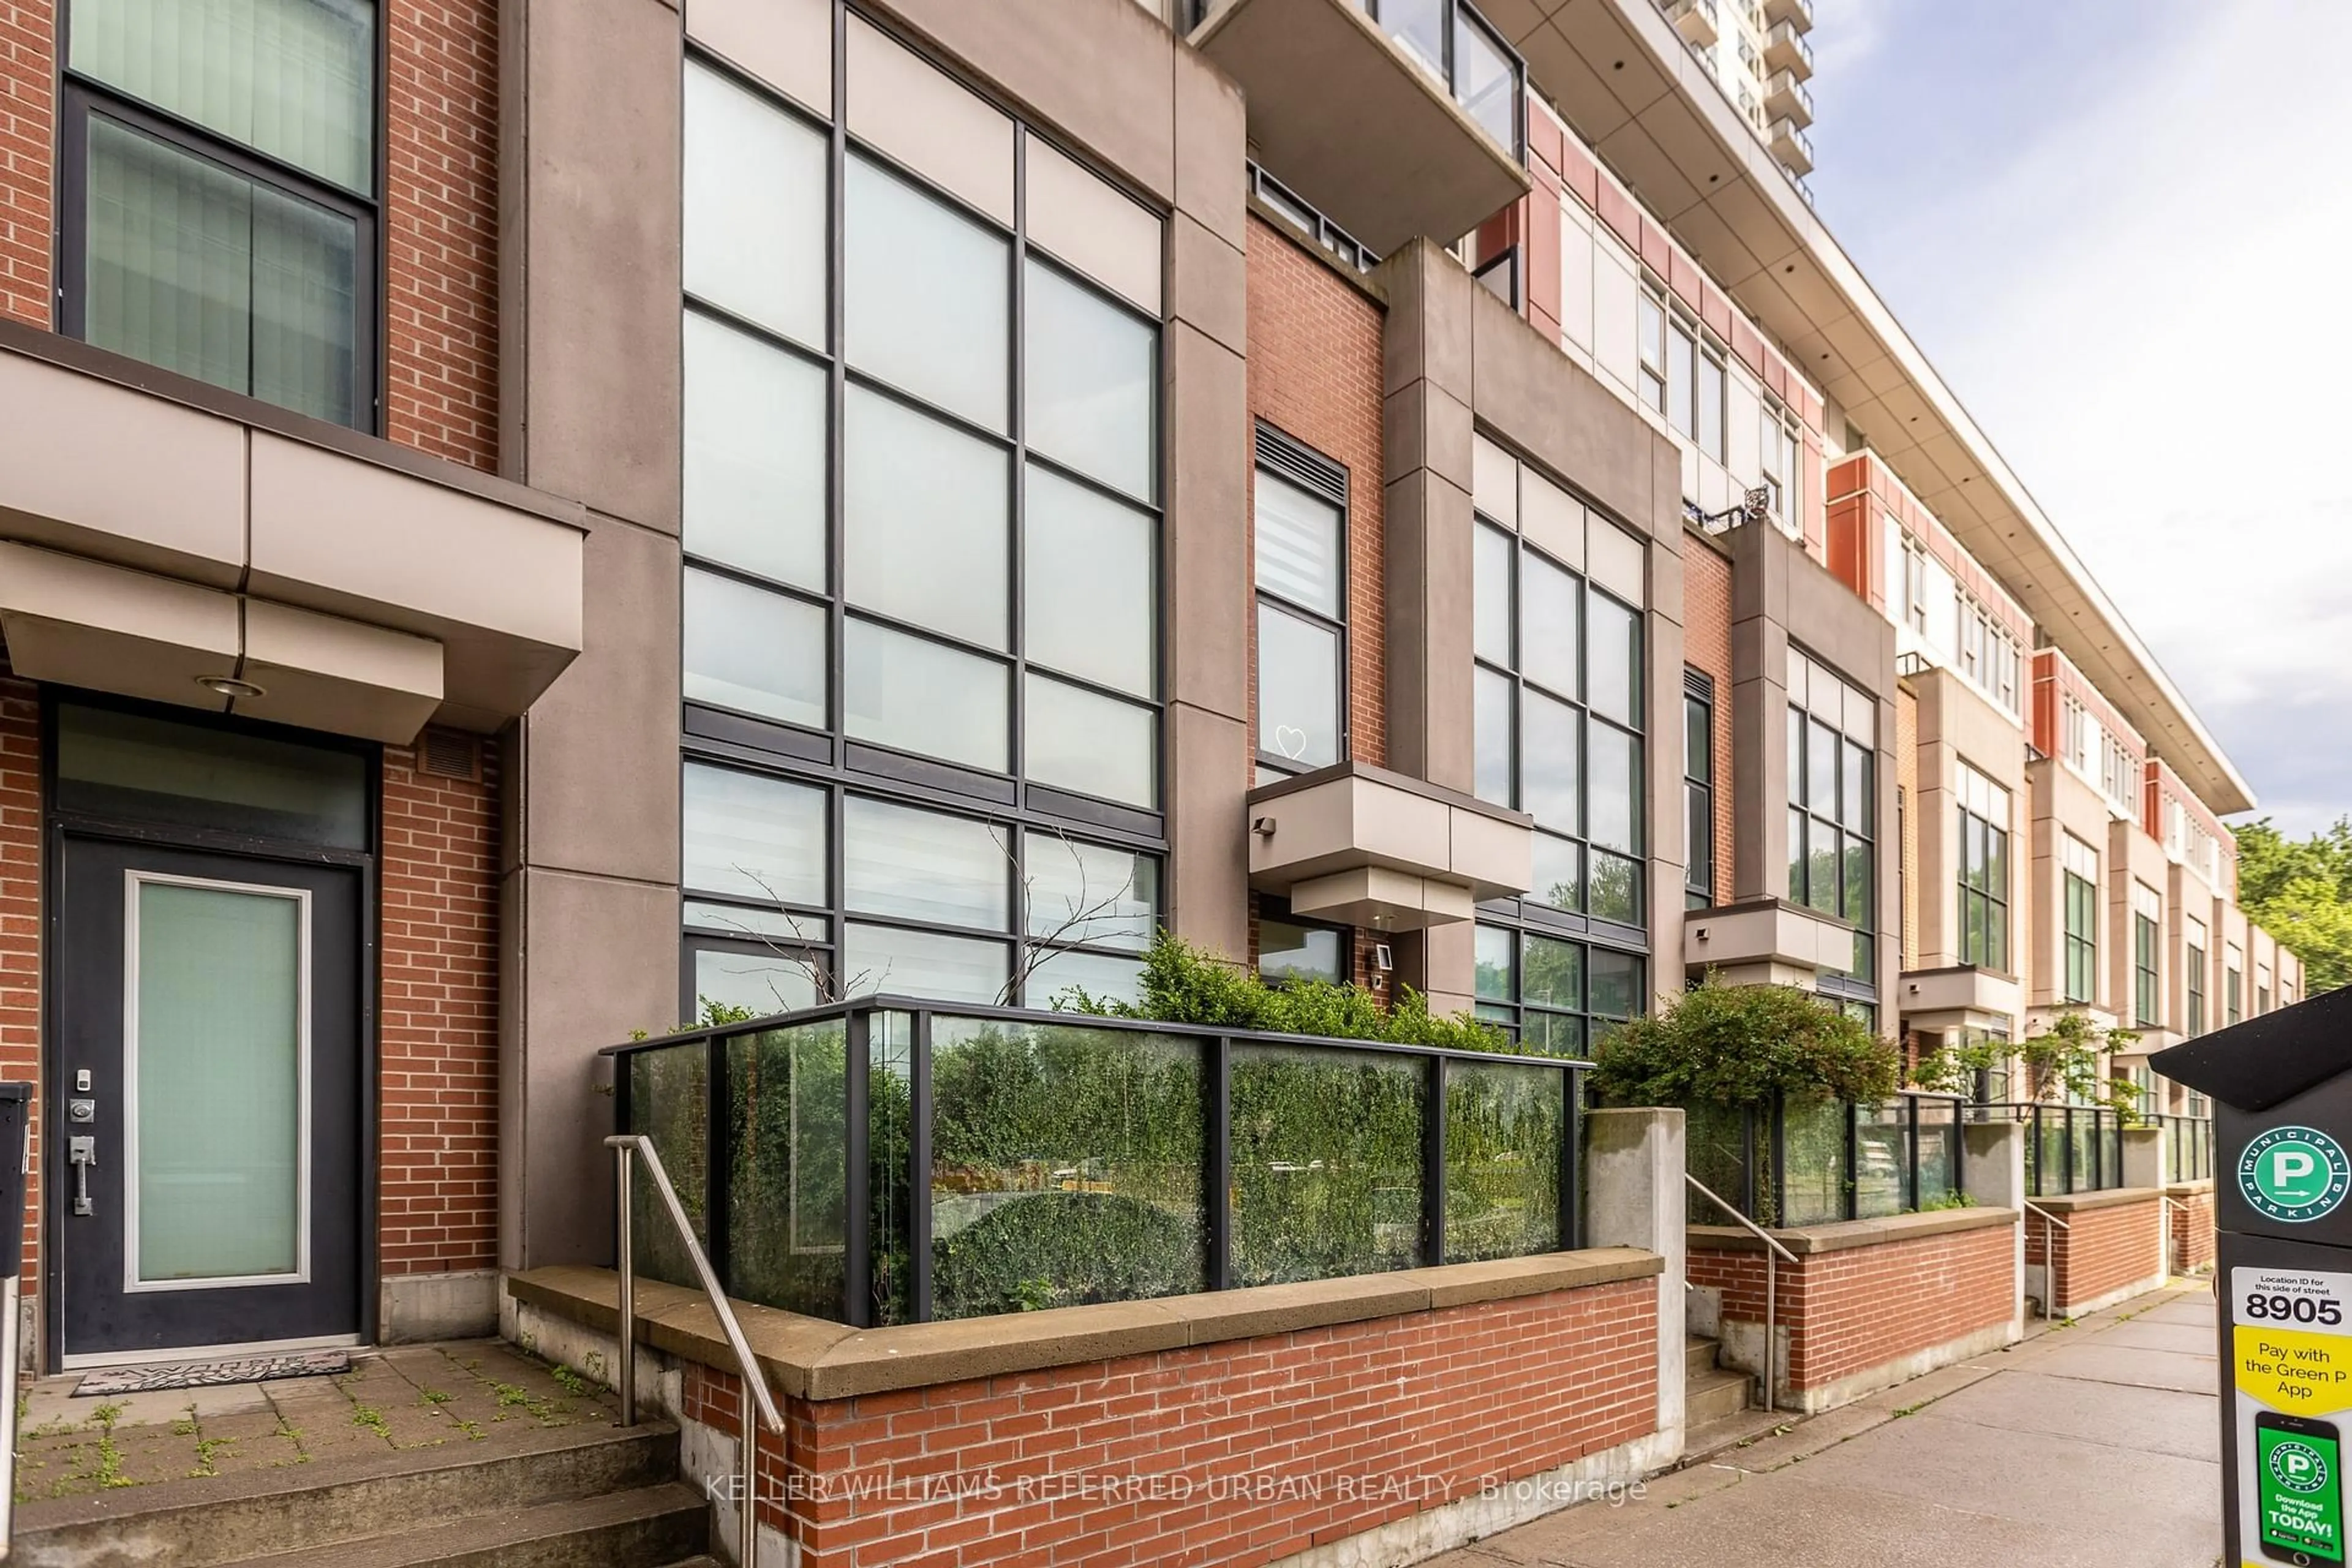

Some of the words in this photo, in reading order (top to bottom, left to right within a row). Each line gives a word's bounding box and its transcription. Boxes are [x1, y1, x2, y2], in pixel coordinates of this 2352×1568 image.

[2244, 1131, 2342, 1170] MUNICIPAL
[2274, 1152, 2314, 1187] P
[2245, 1182, 2342, 1217] PARKING
[2260, 1276, 2297, 1284] Location
[2246, 1294, 2342, 1325] 8905
[2260, 1343, 2288, 1360] Pay
[2293, 1349, 2329, 1363] with
[2246, 1360, 2272, 1374] the
[2277, 1363, 2329, 1381] Green
[2335, 1371, 2346, 1382] P
[2277, 1382, 2312, 1399] App
[2288, 1454, 2310, 1473] P
[2275, 1494, 2323, 1511] Download
[2282, 1504, 2297, 1513] the
[2297, 1508, 2318, 1520] App
[2268, 1510, 2332, 1538] TODAY!
